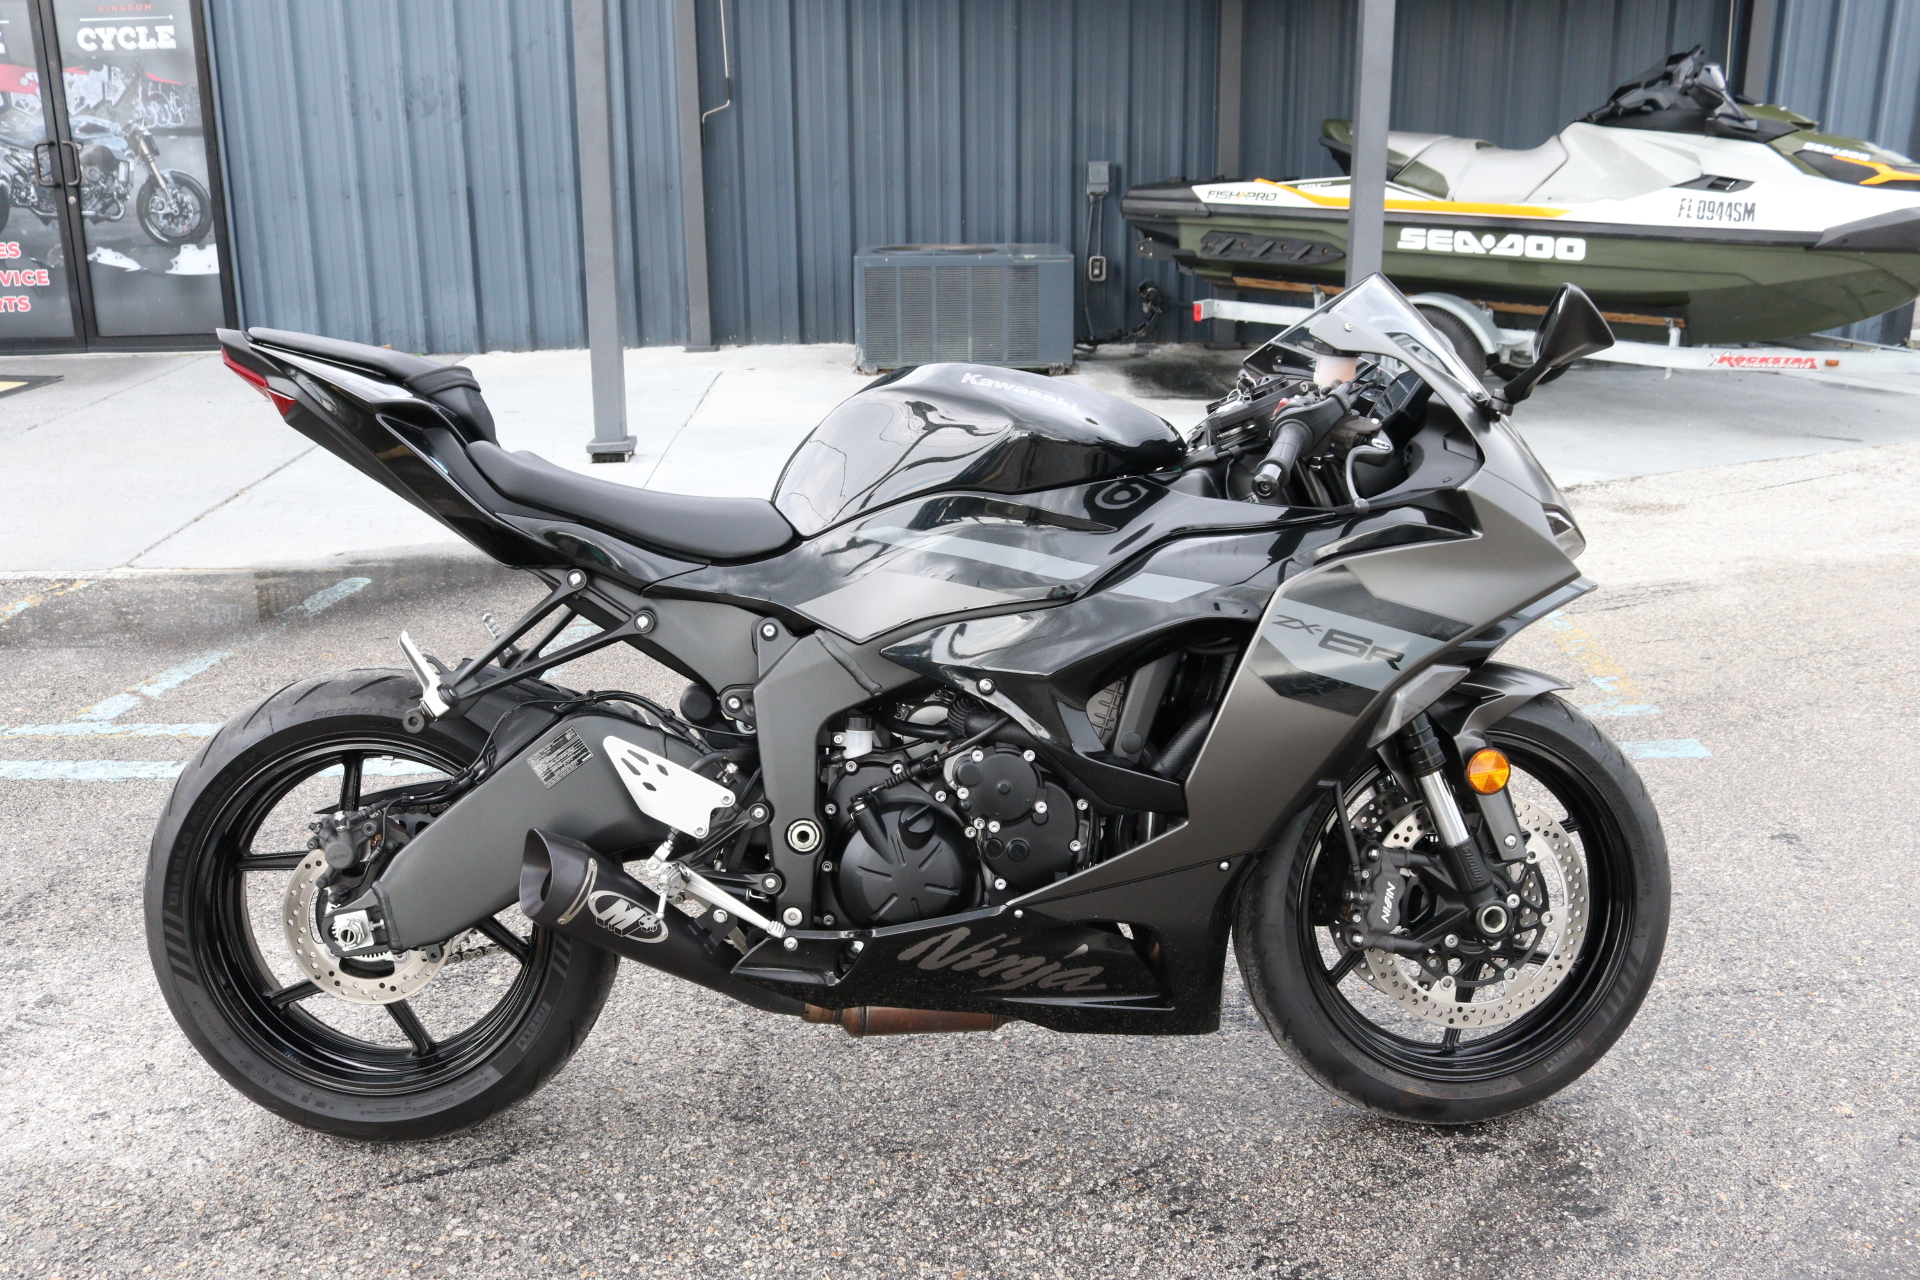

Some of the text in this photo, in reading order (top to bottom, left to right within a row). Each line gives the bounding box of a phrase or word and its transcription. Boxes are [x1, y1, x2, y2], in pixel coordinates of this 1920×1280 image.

[98, 4, 152, 12] KINGDOM
[77, 25, 176, 51] CYCLE
[1678, 198, 1756, 222] FL 0944SM
[1717, 356, 1818, 370] ROCKSTAR
[960, 372, 1079, 412] Kawasaki
[169, 831, 193, 906] DIABLO
[190, 773, 232, 827] ROSSO
[1462, 846, 1483, 883] SHOWA
[897, 926, 1106, 993] Ninja
[516, 1000, 552, 1052] PIRELLI
[1543, 1037, 1585, 1073] PIRELLI
